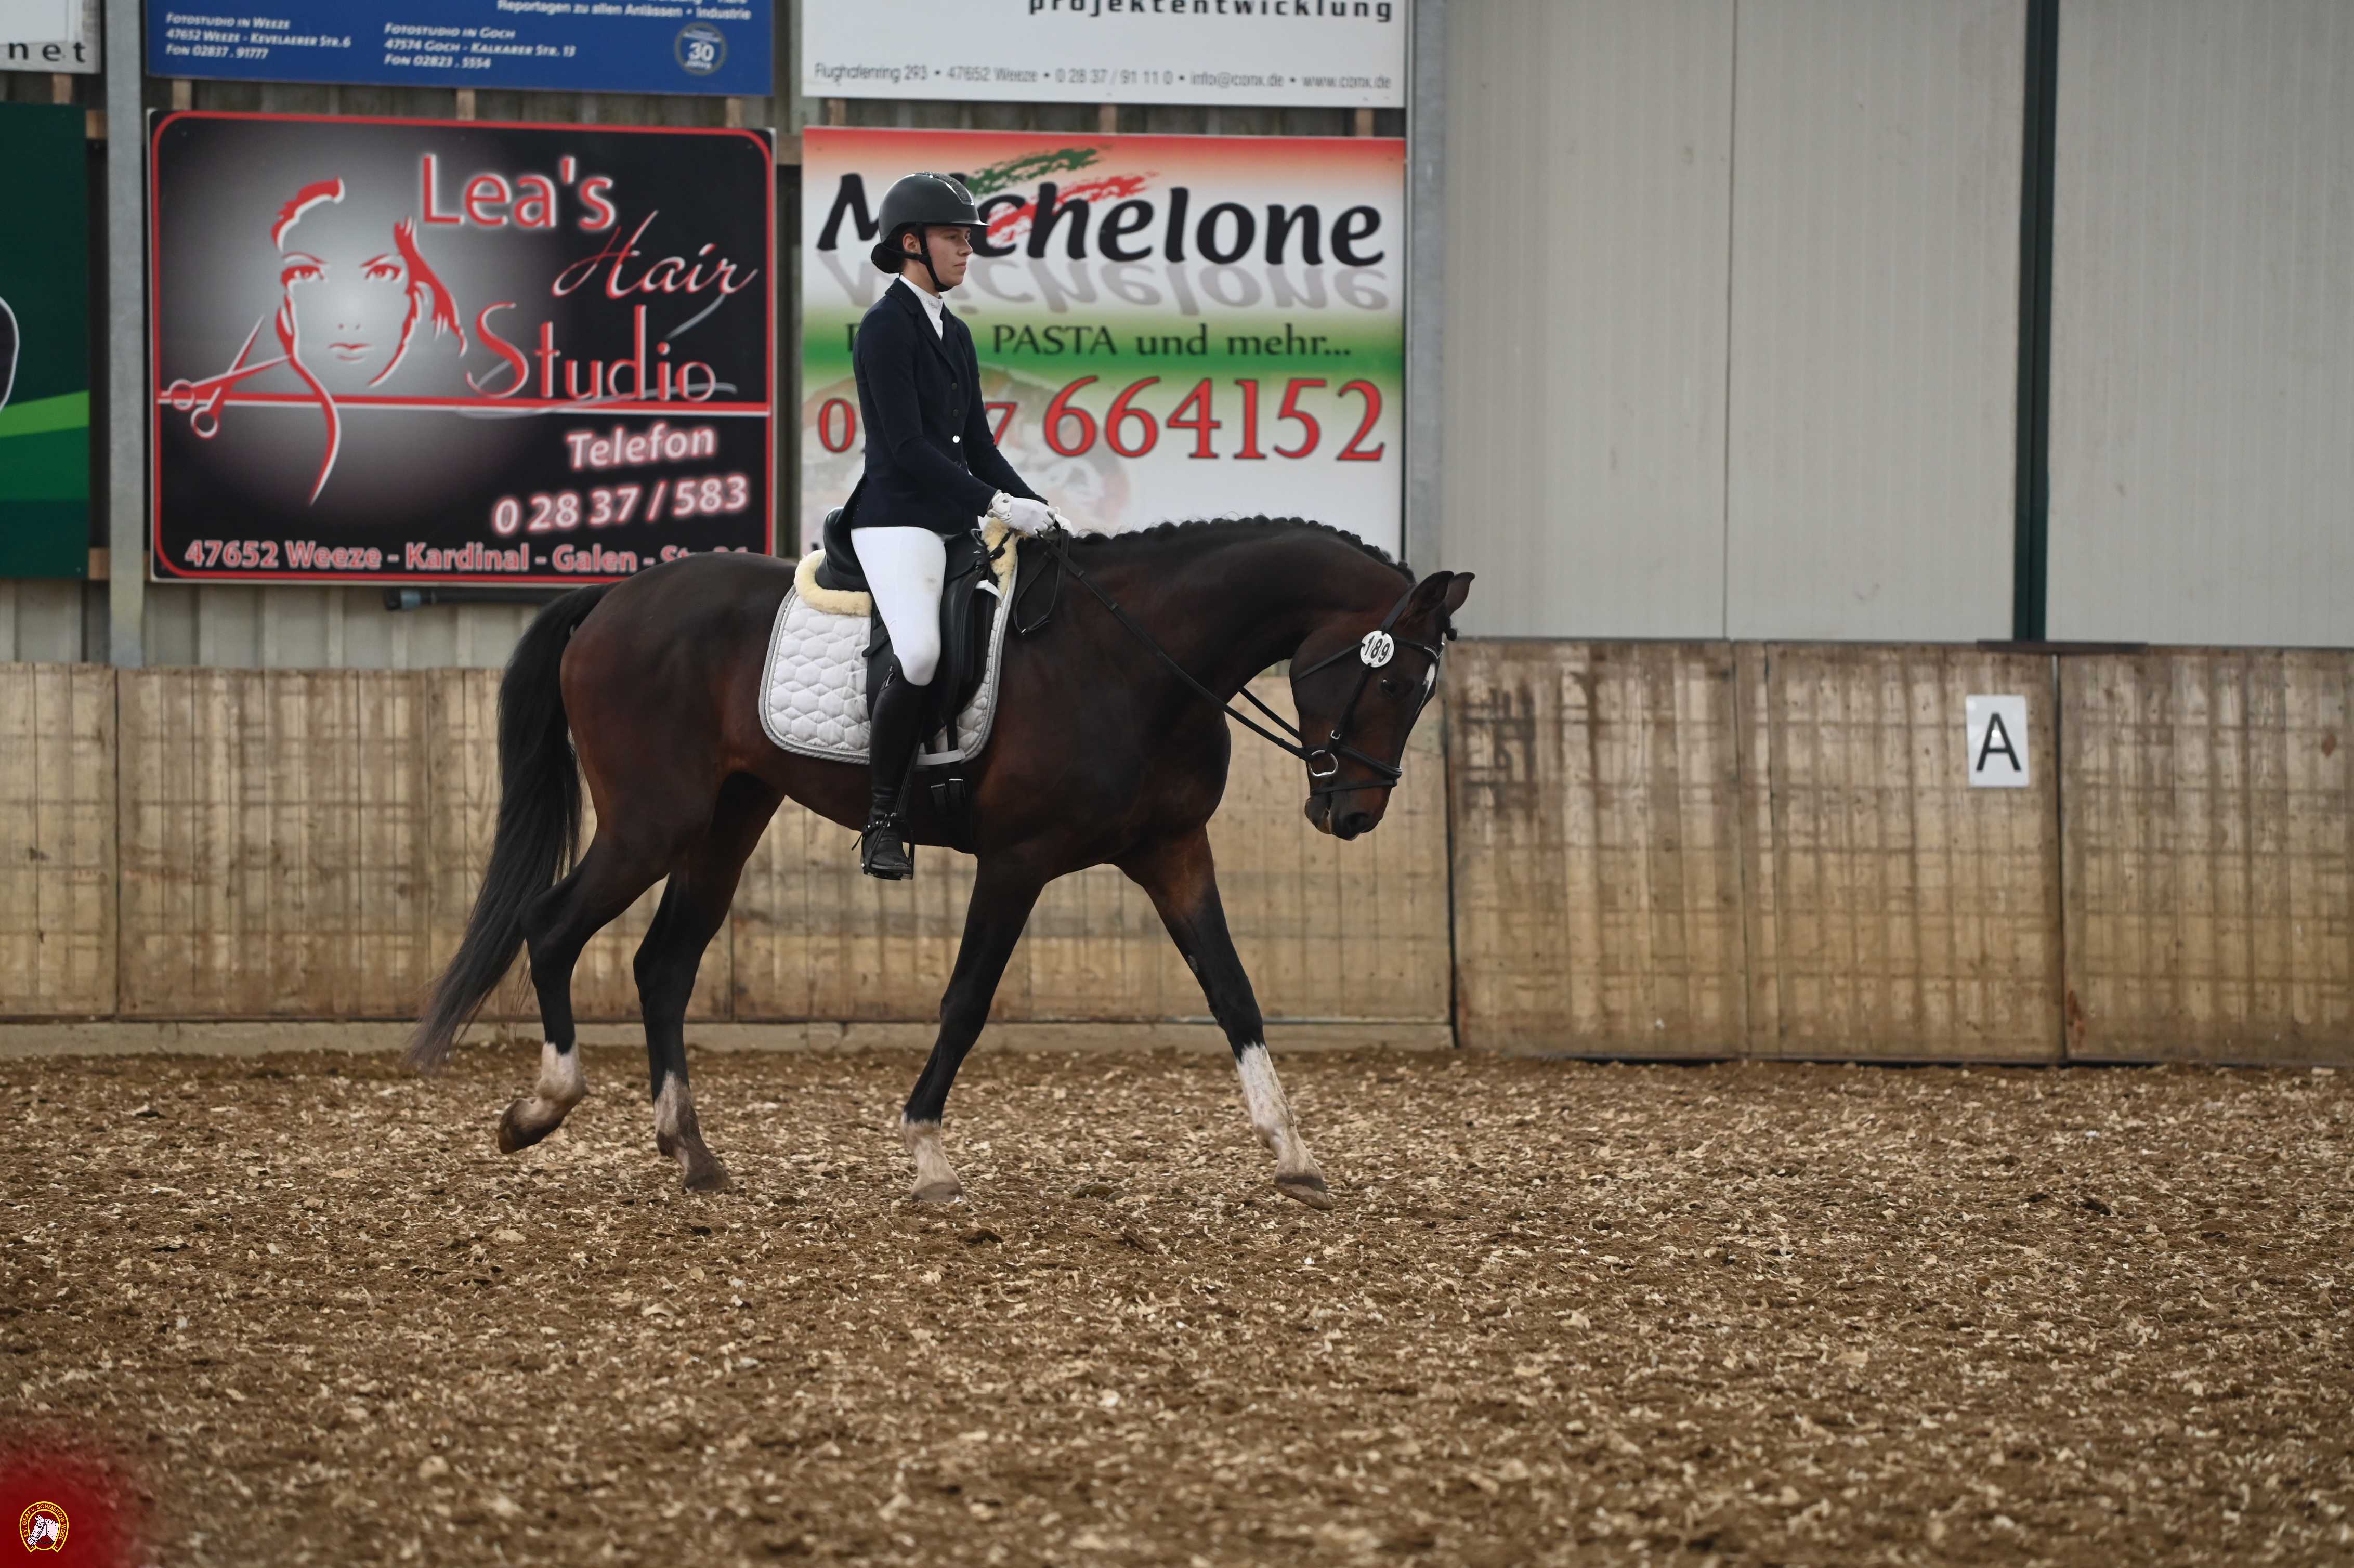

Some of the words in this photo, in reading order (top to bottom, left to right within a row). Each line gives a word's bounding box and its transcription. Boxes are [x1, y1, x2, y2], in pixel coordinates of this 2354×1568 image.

[497, 0, 571, 15] Reportagen
[573, 4, 589, 14] zu
[592, 4, 623, 16] allen
[624, 5, 683, 18] Anlässen
[1029, 0, 1391, 22] projektentwicklung
[9, 41, 86, 63] net
[166, 28, 201, 41] 47652
[688, 42, 715, 61] 30
[815, 62, 901, 85] Flughafenring
[905, 64, 928, 81] 293
[947, 66, 991, 82] 47652
[995, 66, 1038, 83] Weeze
[422, 154, 617, 230] Lea's
[816, 173, 1385, 267] Mchelone
[551, 210, 759, 300] Hair
[466, 300, 717, 403] Studio
[992, 324, 1118, 356] PASTA
[1135, 323, 1208, 356] und
[1227, 322, 1352, 357] mehr...
[1044, 374, 1387, 462] 664152
[565, 419, 717, 469] Telefon
[493, 498, 519, 535] 0
[528, 491, 581, 532] 28
[588, 484, 642, 526] 37
[672, 472, 749, 516] 583
[185, 539, 279, 569] 47652
[285, 540, 382, 570] Weeze
[406, 541, 529, 572] Kardinal
[552, 544, 637, 573] Galen
[1364, 635, 1390, 663] 189
[1976, 712, 2022, 772] A
